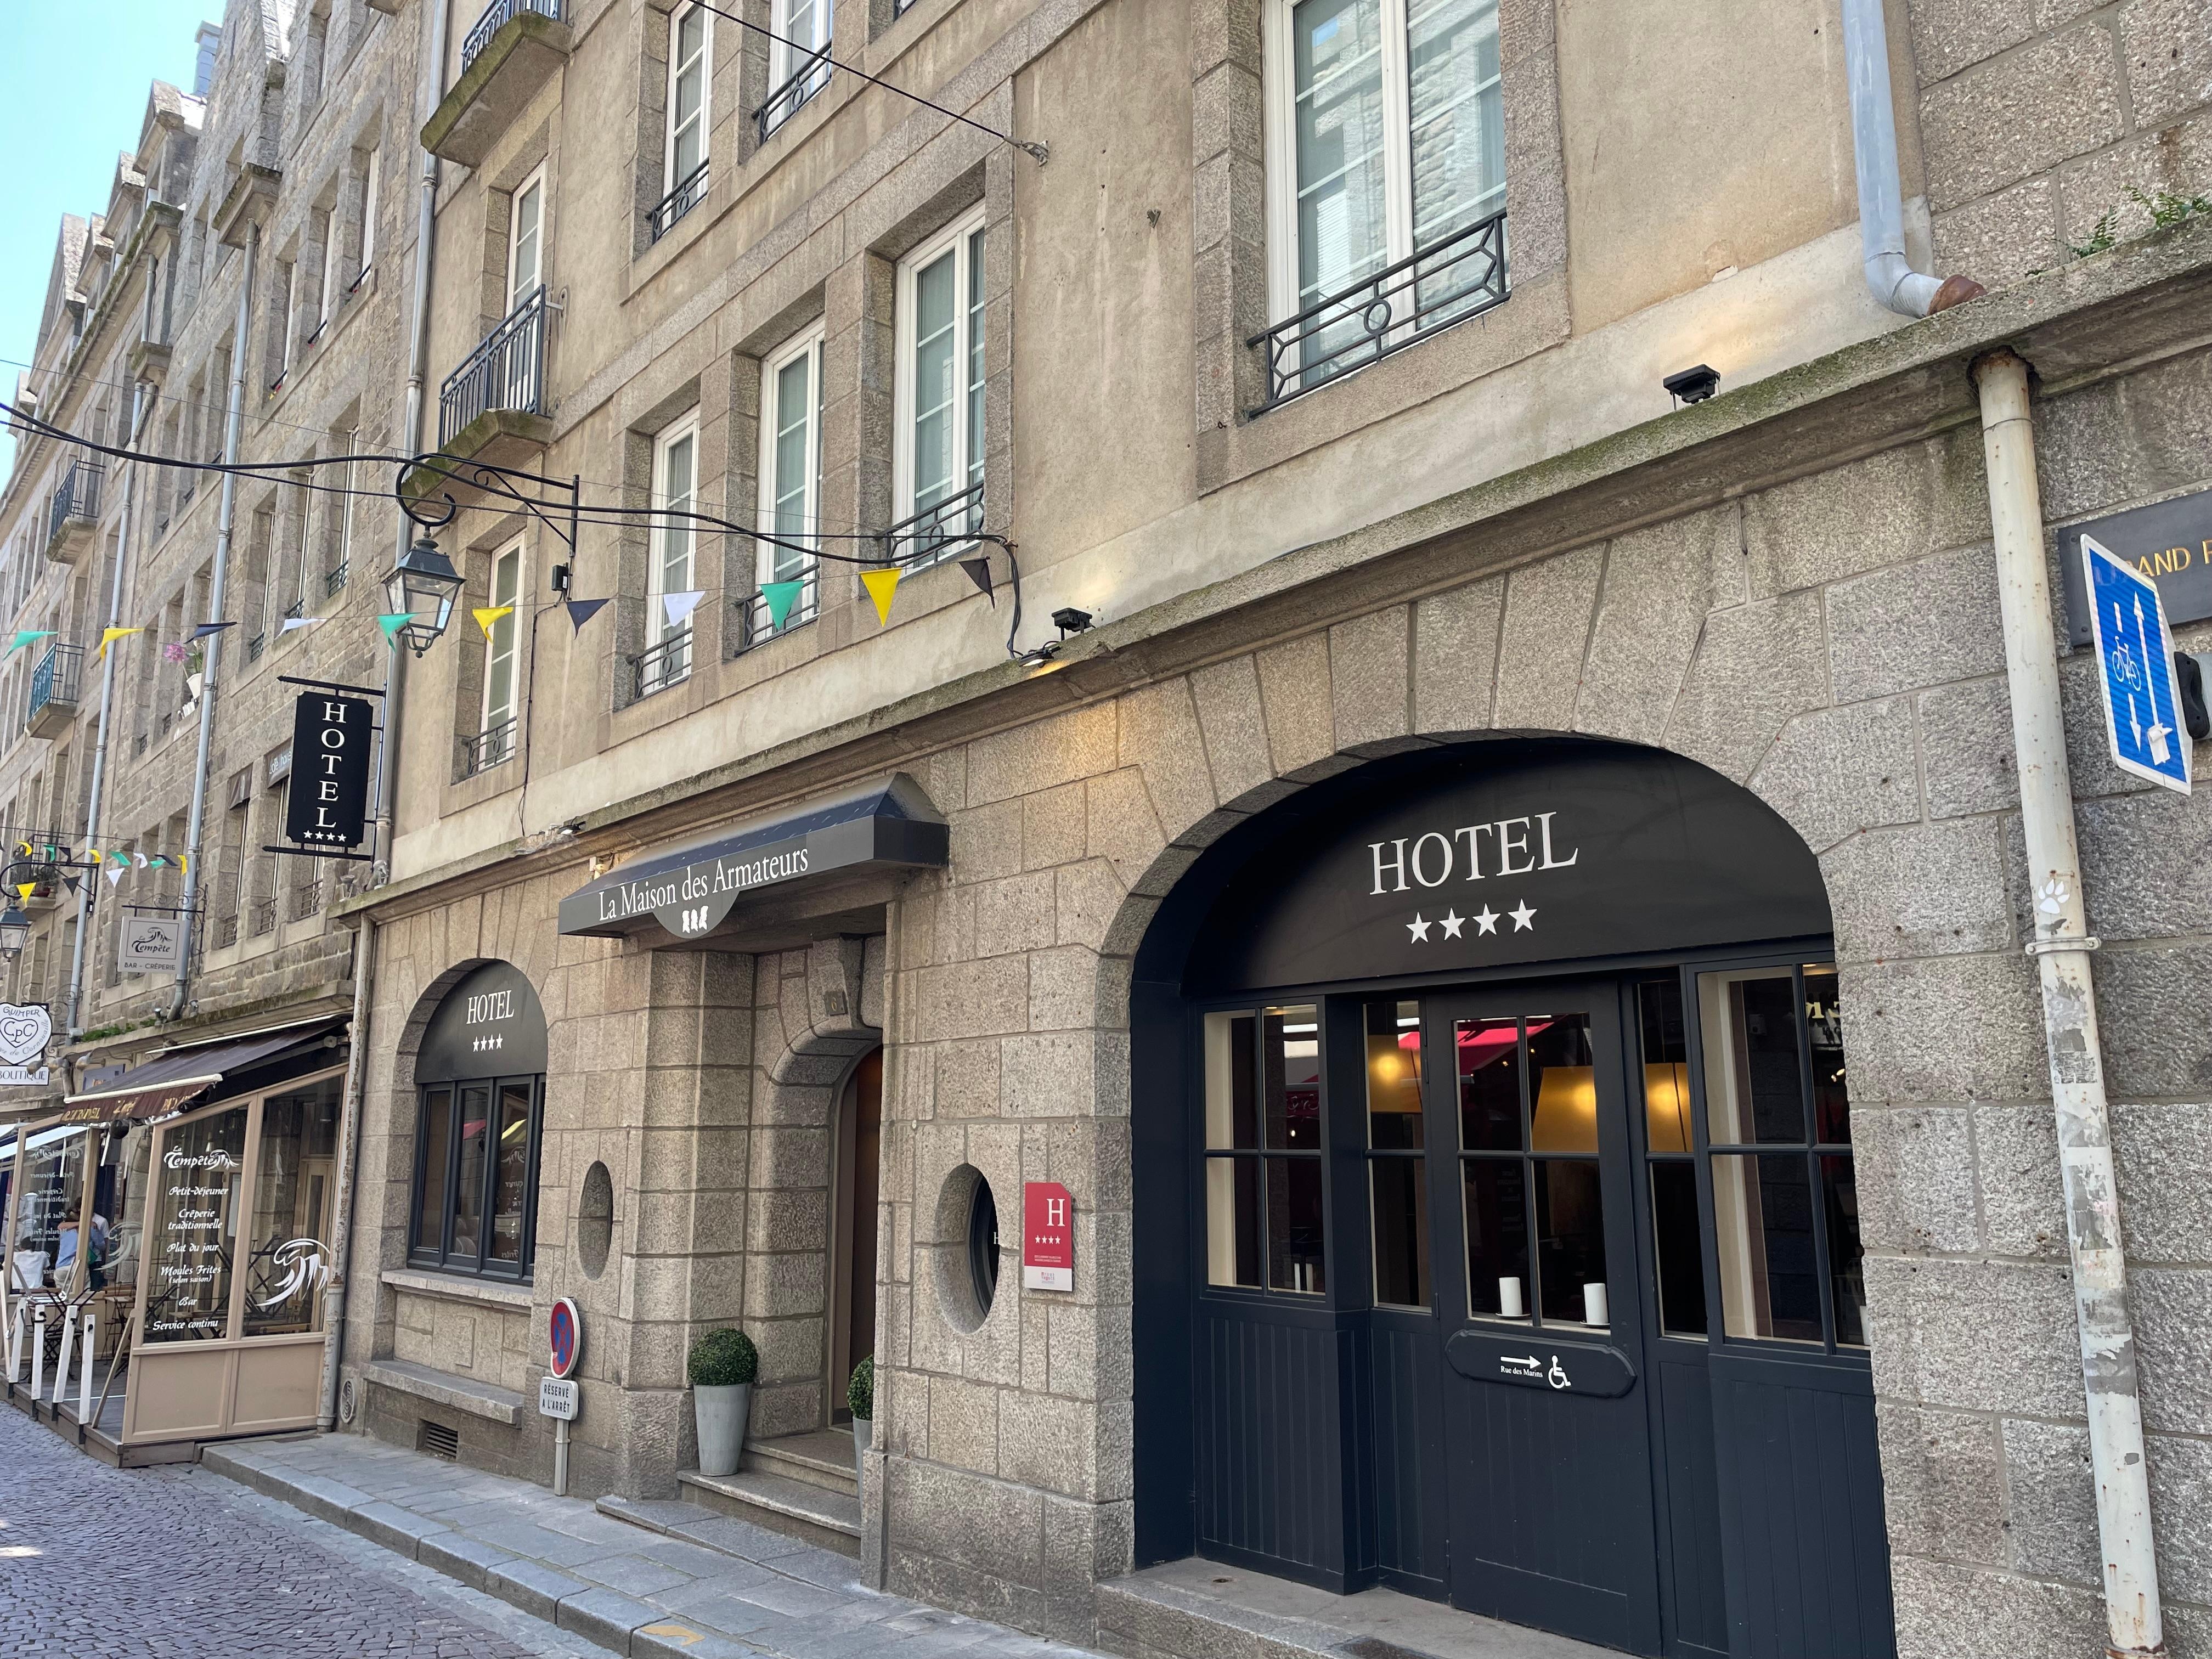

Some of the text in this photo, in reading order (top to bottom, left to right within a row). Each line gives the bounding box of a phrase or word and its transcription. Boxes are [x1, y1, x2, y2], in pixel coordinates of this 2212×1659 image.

[2125, 547, 2191, 577] AND
[315, 701, 348, 828] HOTEL
[1368, 811, 1578, 895] HOTEL
[599, 848, 809, 921] La Maison des Armateurs
[132, 940, 171, 953] Tempête
[466, 990, 515, 1024] HOTEL
[163, 1152, 215, 1169] Tempête
[178, 1208, 215, 1220] Crêperie
[1046, 1198, 1066, 1227] H
[168, 1218, 223, 1230] traditionnelle
[166, 1242, 219, 1253] Plat du jour
[161, 1264, 221, 1277] Moules Frites
[178, 1296, 198, 1306] Bar
[153, 1318, 219, 1331] Service continu
[1500, 1365, 1512, 1374] Rue
[1523, 1368, 1543, 1378] Marins
[544, 1383, 569, 1398] RÉSERVÉ
